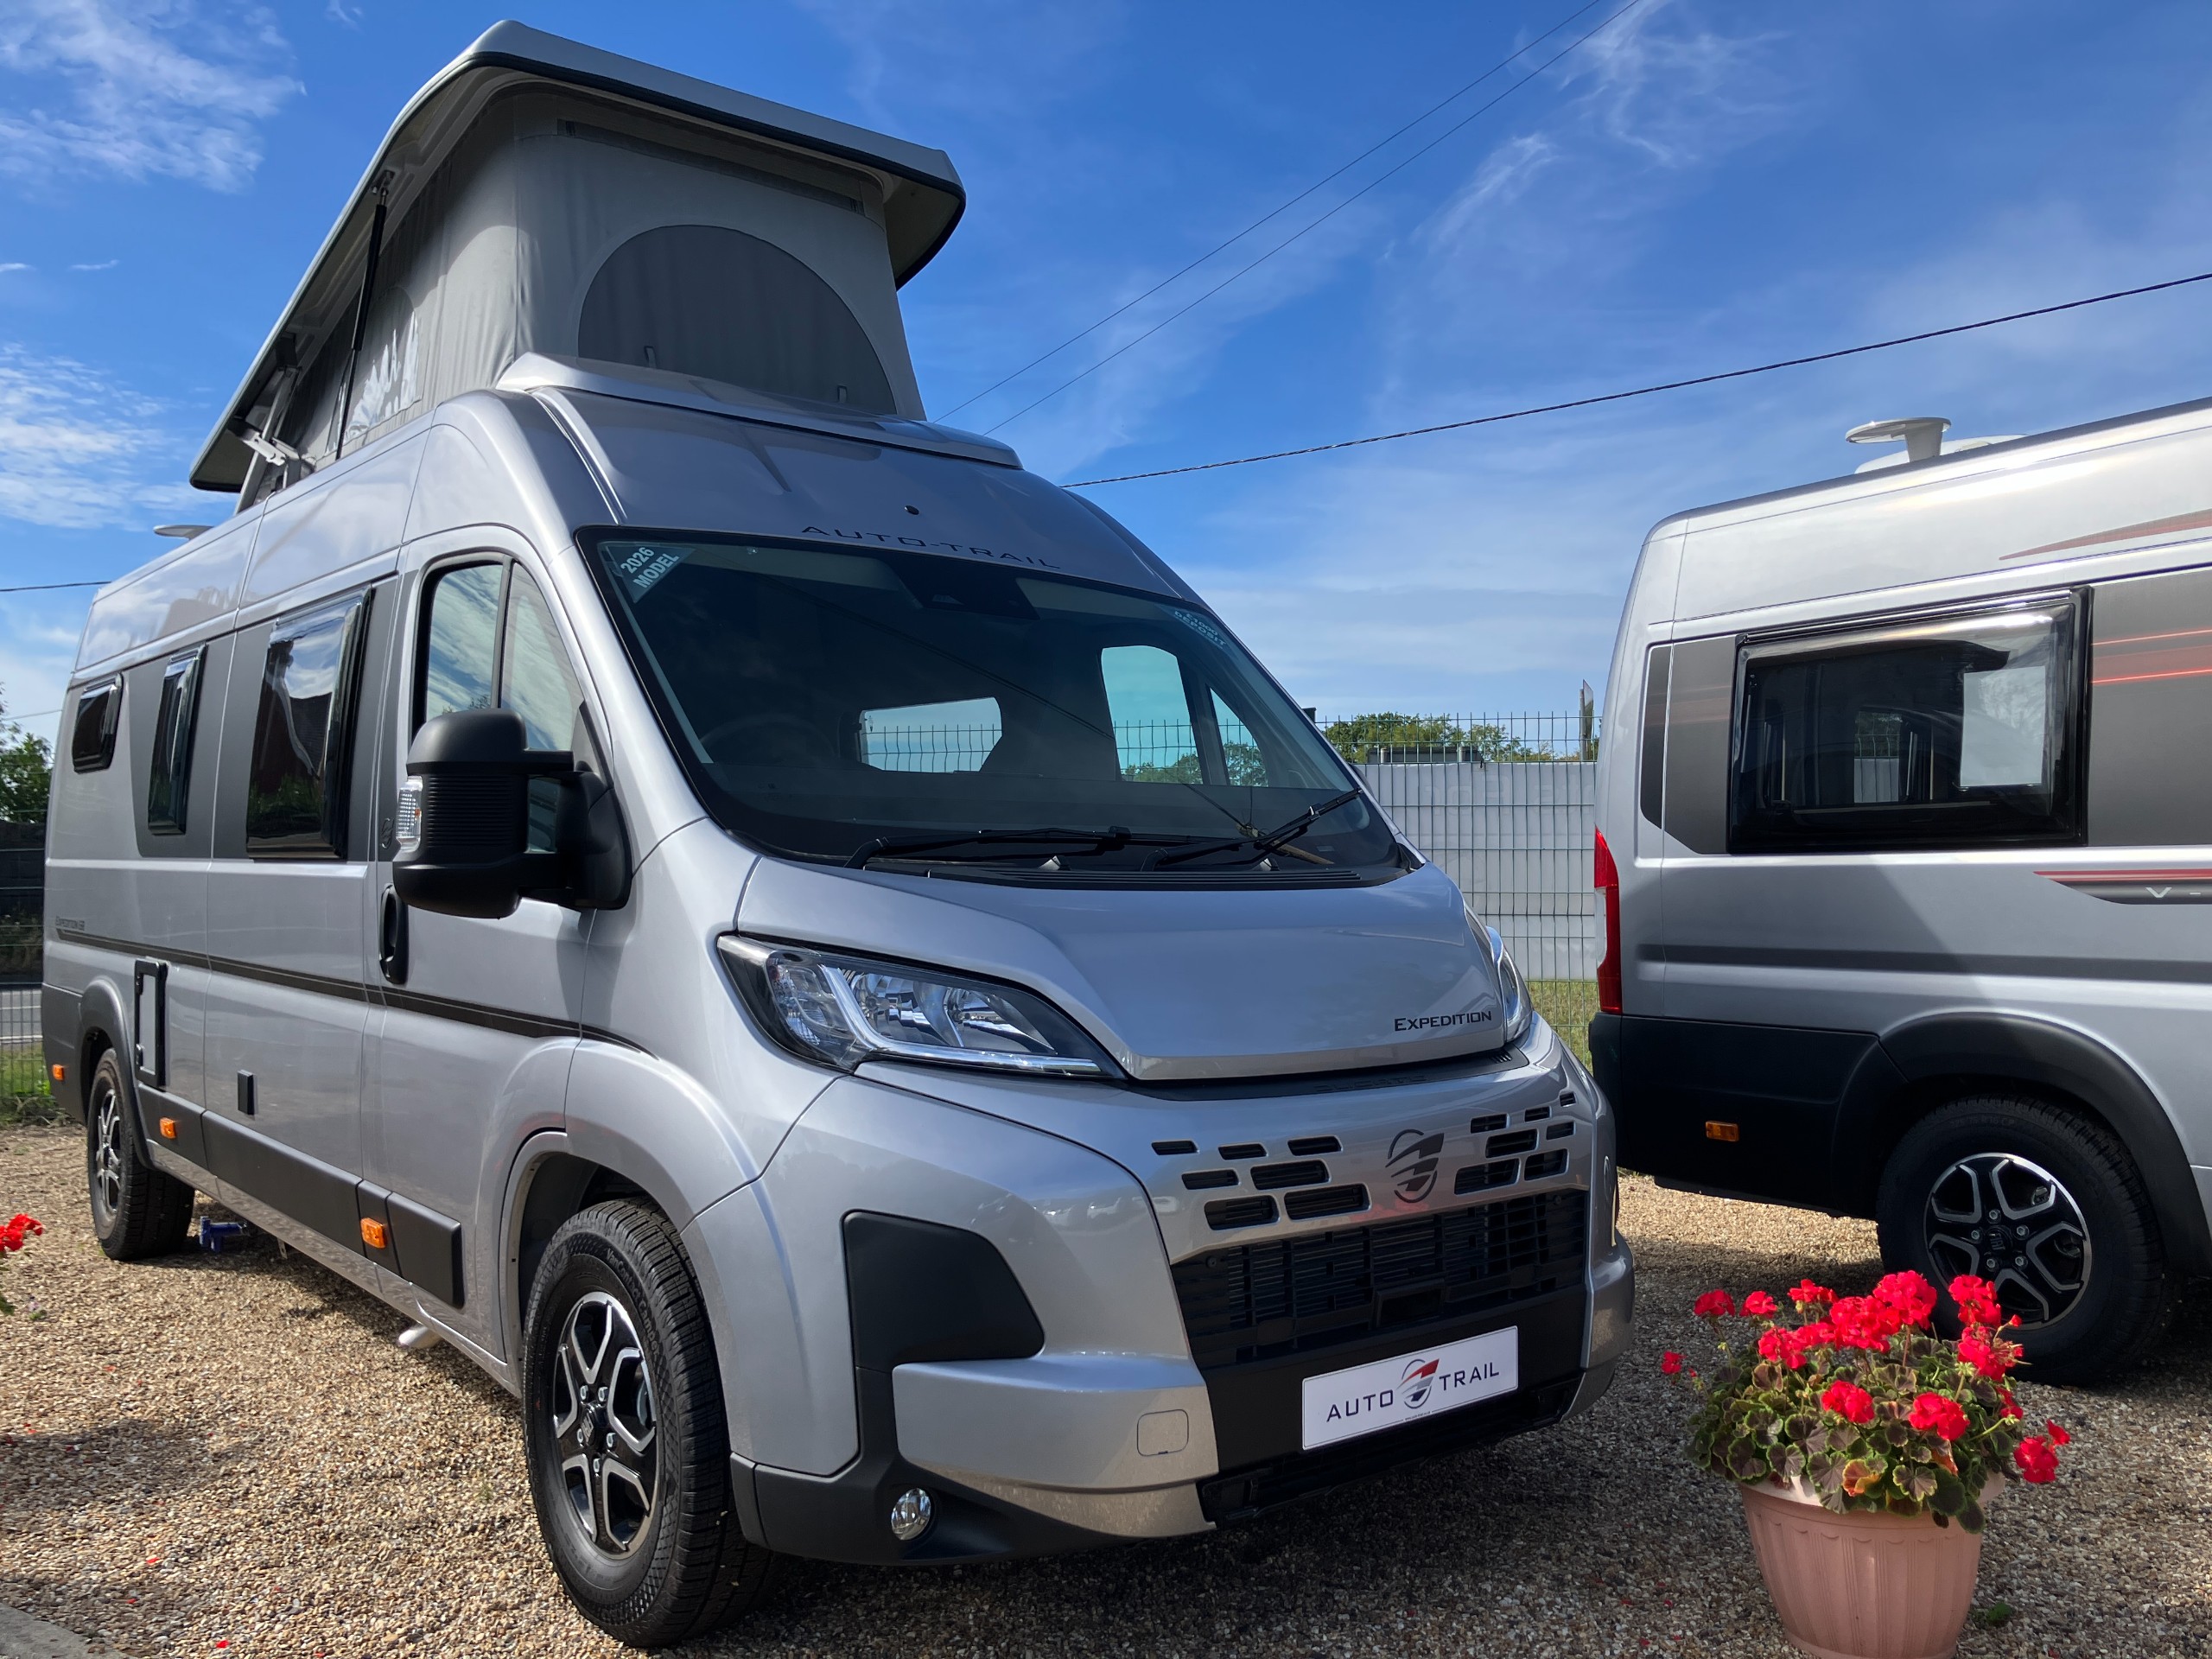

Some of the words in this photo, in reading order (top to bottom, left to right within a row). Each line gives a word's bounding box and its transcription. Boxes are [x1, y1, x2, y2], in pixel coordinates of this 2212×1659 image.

[620, 547, 655, 574] 2026
[801, 526, 1061, 569] AUTO-TRAIL
[632, 553, 680, 588] MODEL
[1174, 610, 1226, 645] DEPOSIT
[1394, 1011, 1492, 1032] EXPEDITION
[639, 1300, 658, 1363] Camper
[1326, 1389, 1393, 1422] AUTO
[1439, 1362, 1500, 1391] TRAIL
